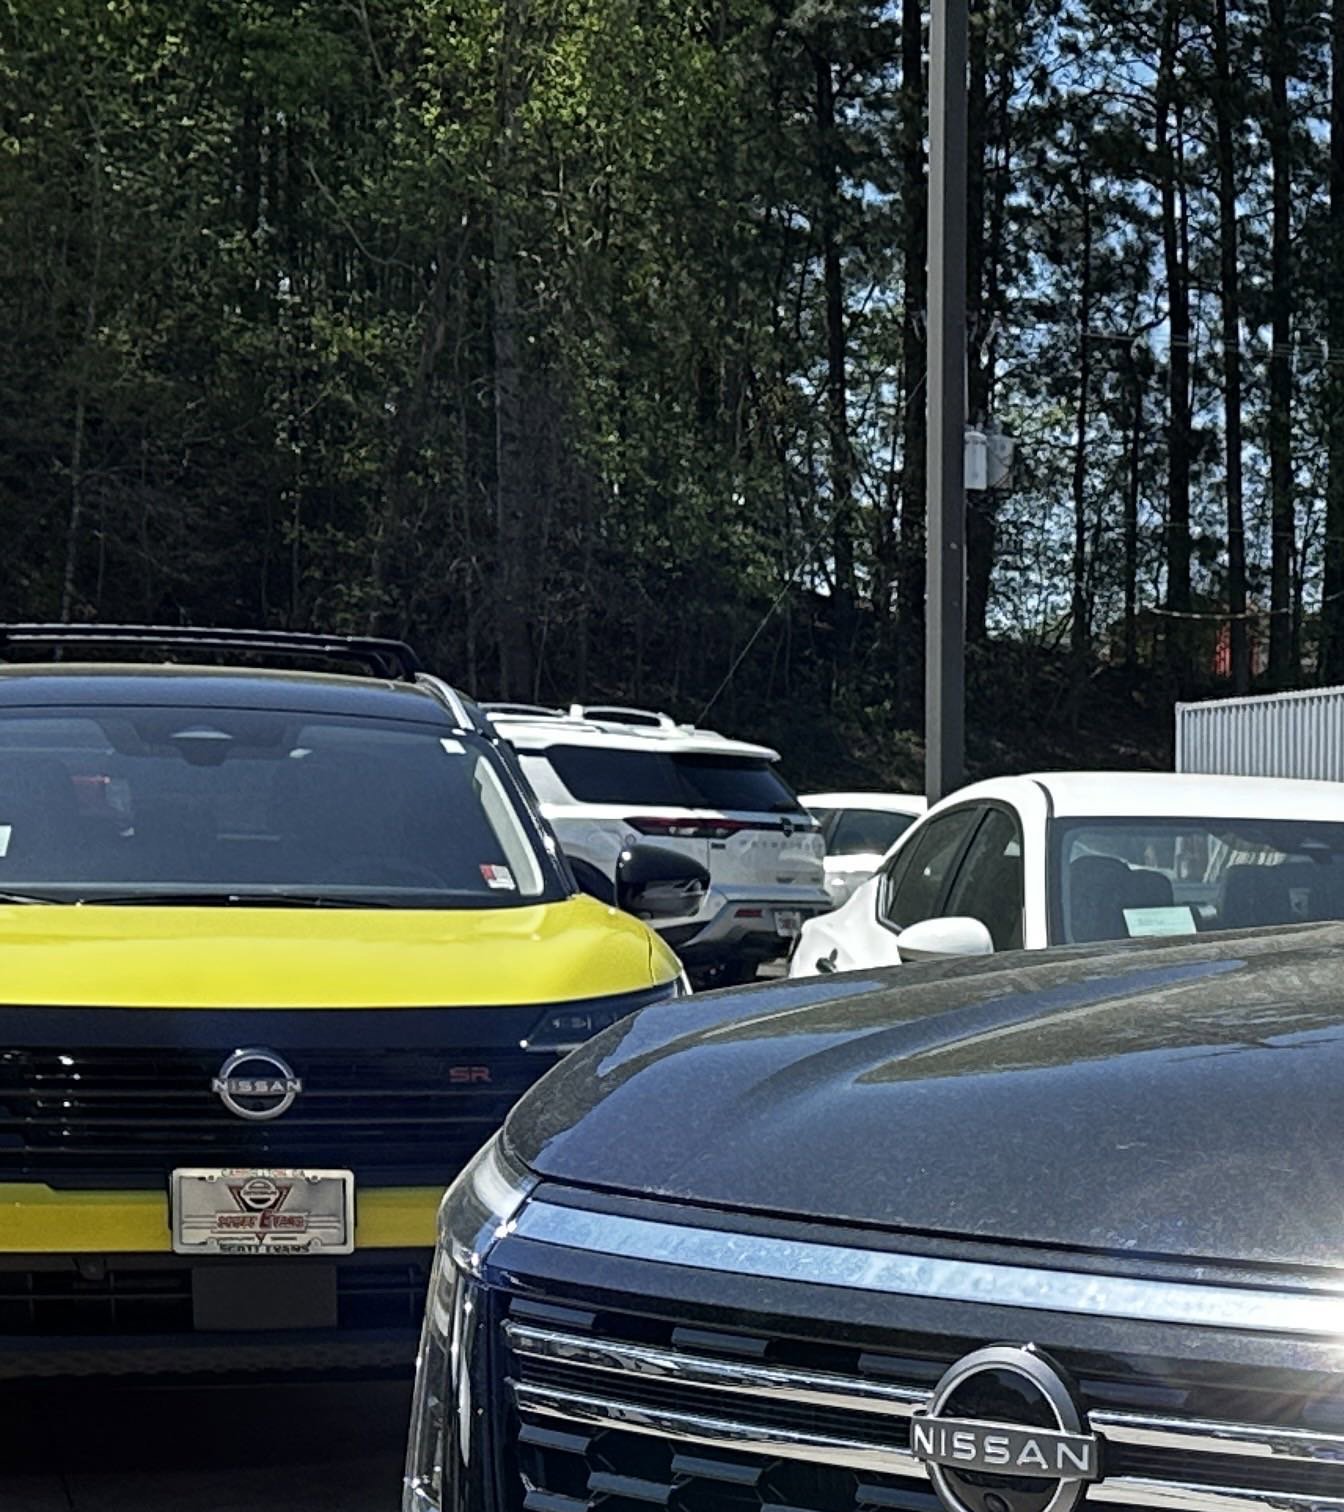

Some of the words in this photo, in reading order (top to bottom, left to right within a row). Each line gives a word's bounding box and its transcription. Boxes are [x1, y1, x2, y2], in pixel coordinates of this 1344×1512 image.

[448, 1066, 493, 1083] SR
[213, 1078, 302, 1093] NISSAN
[912, 1423, 1090, 1472] NISSAN
